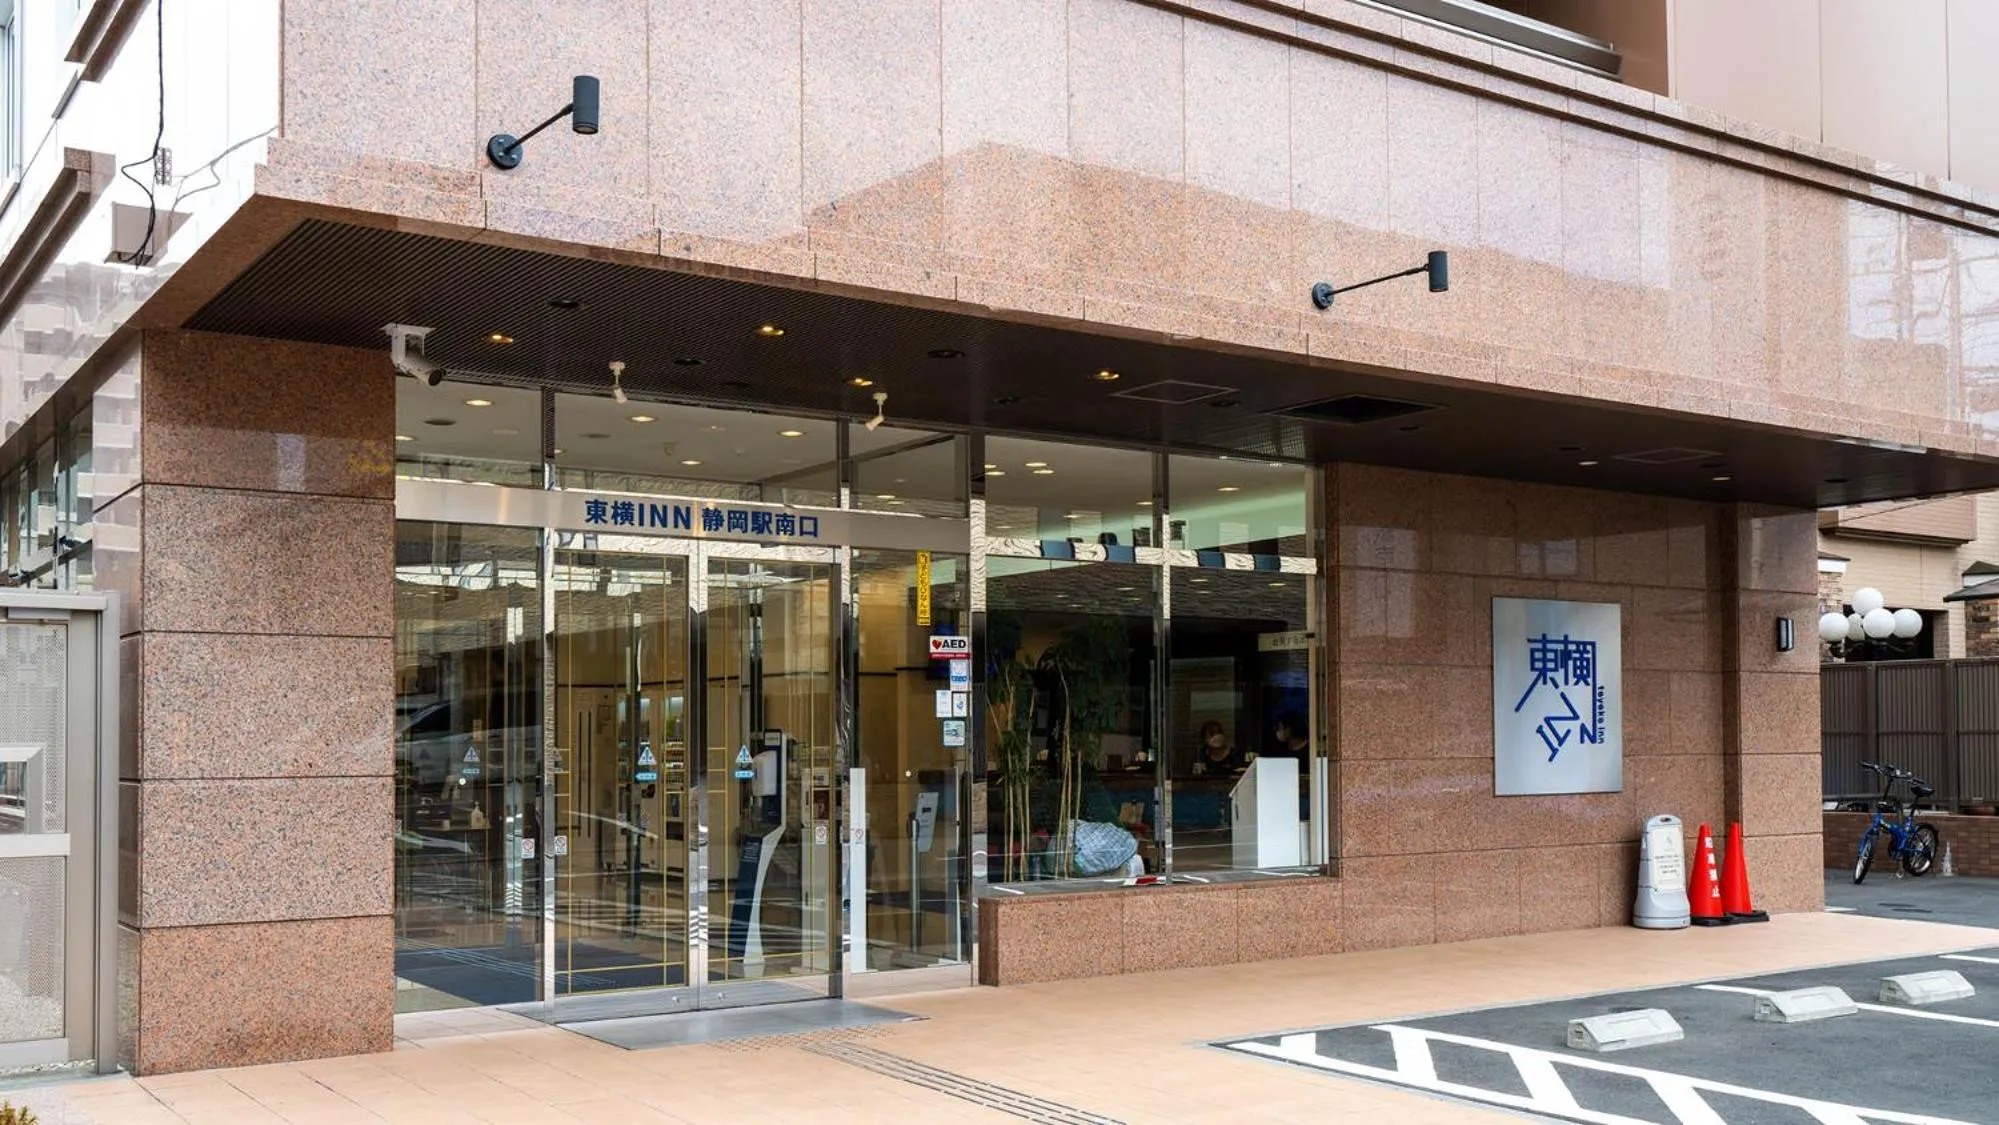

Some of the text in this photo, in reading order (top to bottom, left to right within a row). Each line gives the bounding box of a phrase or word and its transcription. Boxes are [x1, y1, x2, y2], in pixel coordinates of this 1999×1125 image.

[585, 499, 819, 538] 東横INN 静岡駅南口
[942, 639, 966, 649] AED
